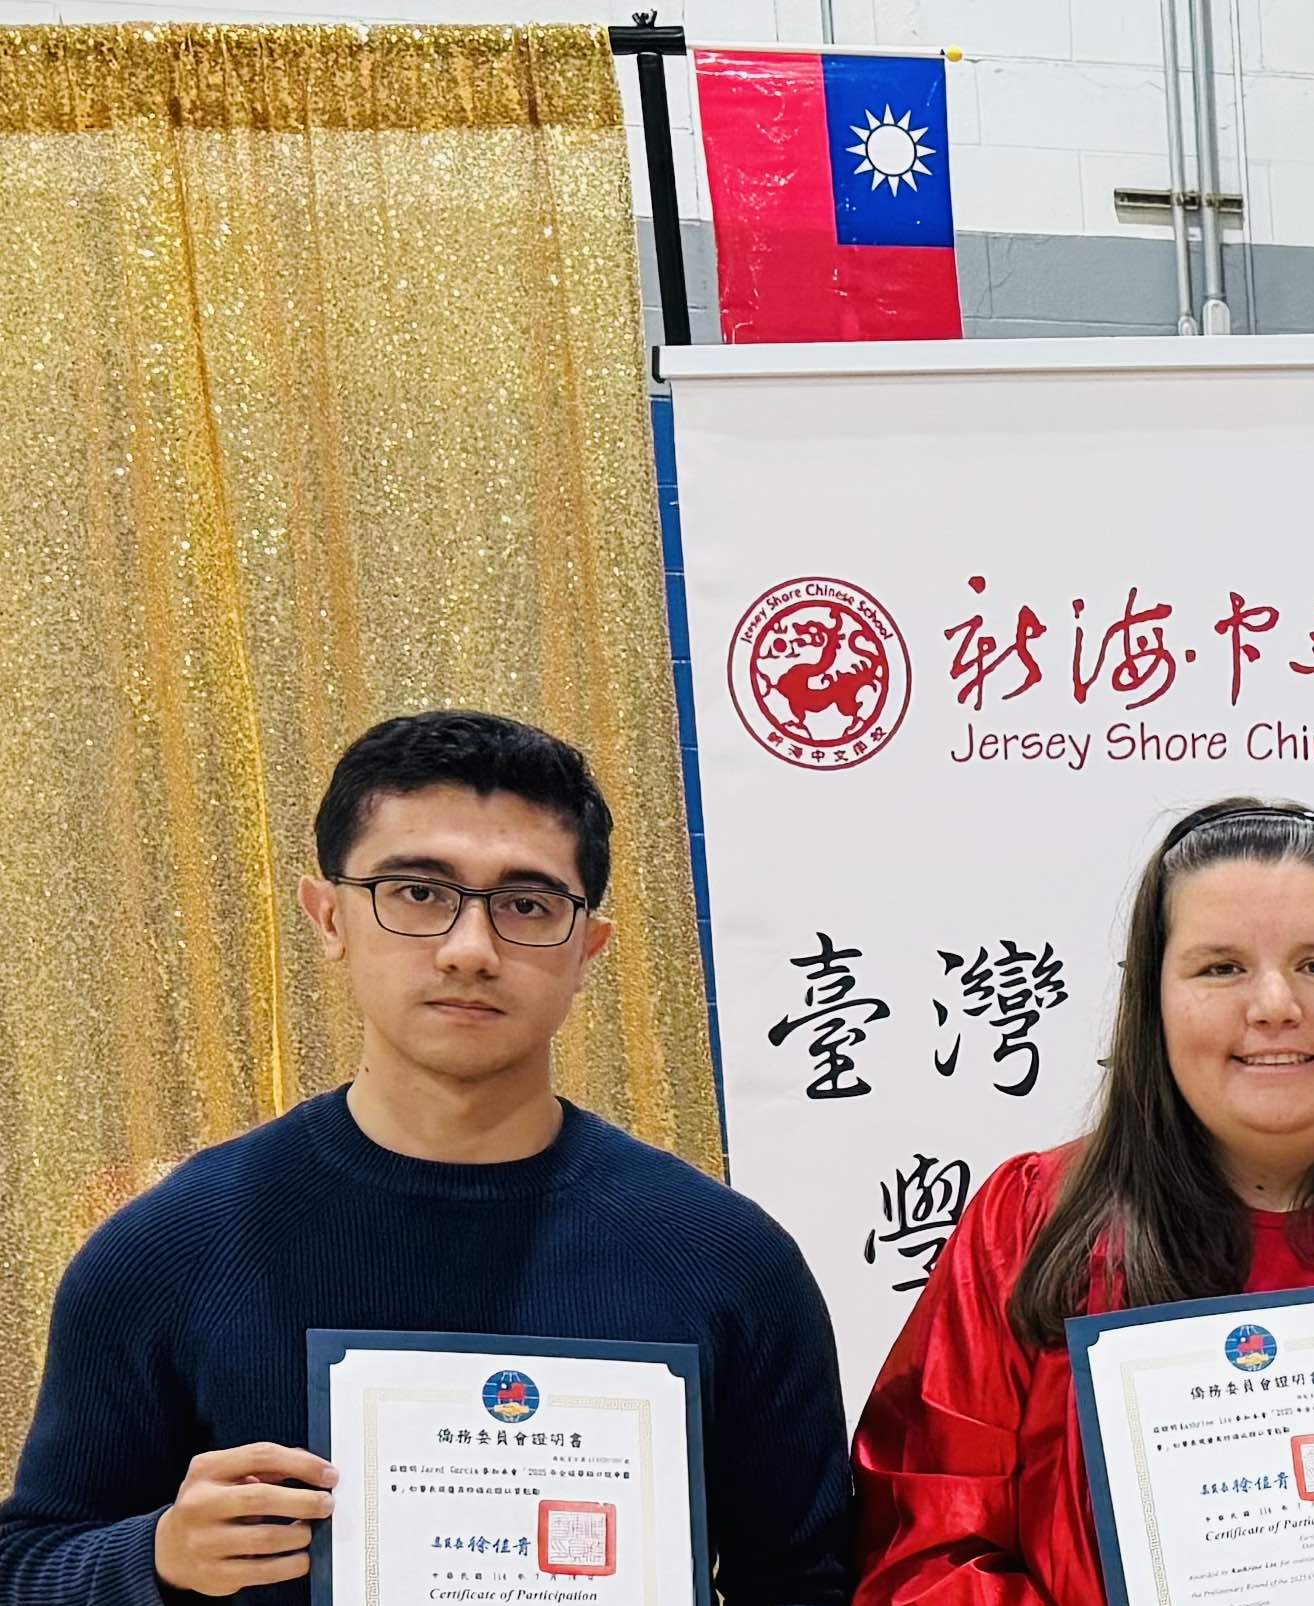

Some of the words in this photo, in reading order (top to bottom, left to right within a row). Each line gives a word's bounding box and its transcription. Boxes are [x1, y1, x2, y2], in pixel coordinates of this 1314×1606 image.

[741, 606, 768, 644] Jersey
[766, 587, 801, 611] Shore
[805, 583, 855, 605] Chinese
[857, 600, 893, 641] School
[950, 722, 1091, 770] Jersey
[1105, 722, 1228, 762] Shore
[429, 1588, 495, 1602] Certificate
[500, 1588, 515, 1602] of
[517, 1589, 597, 1602] Participation
